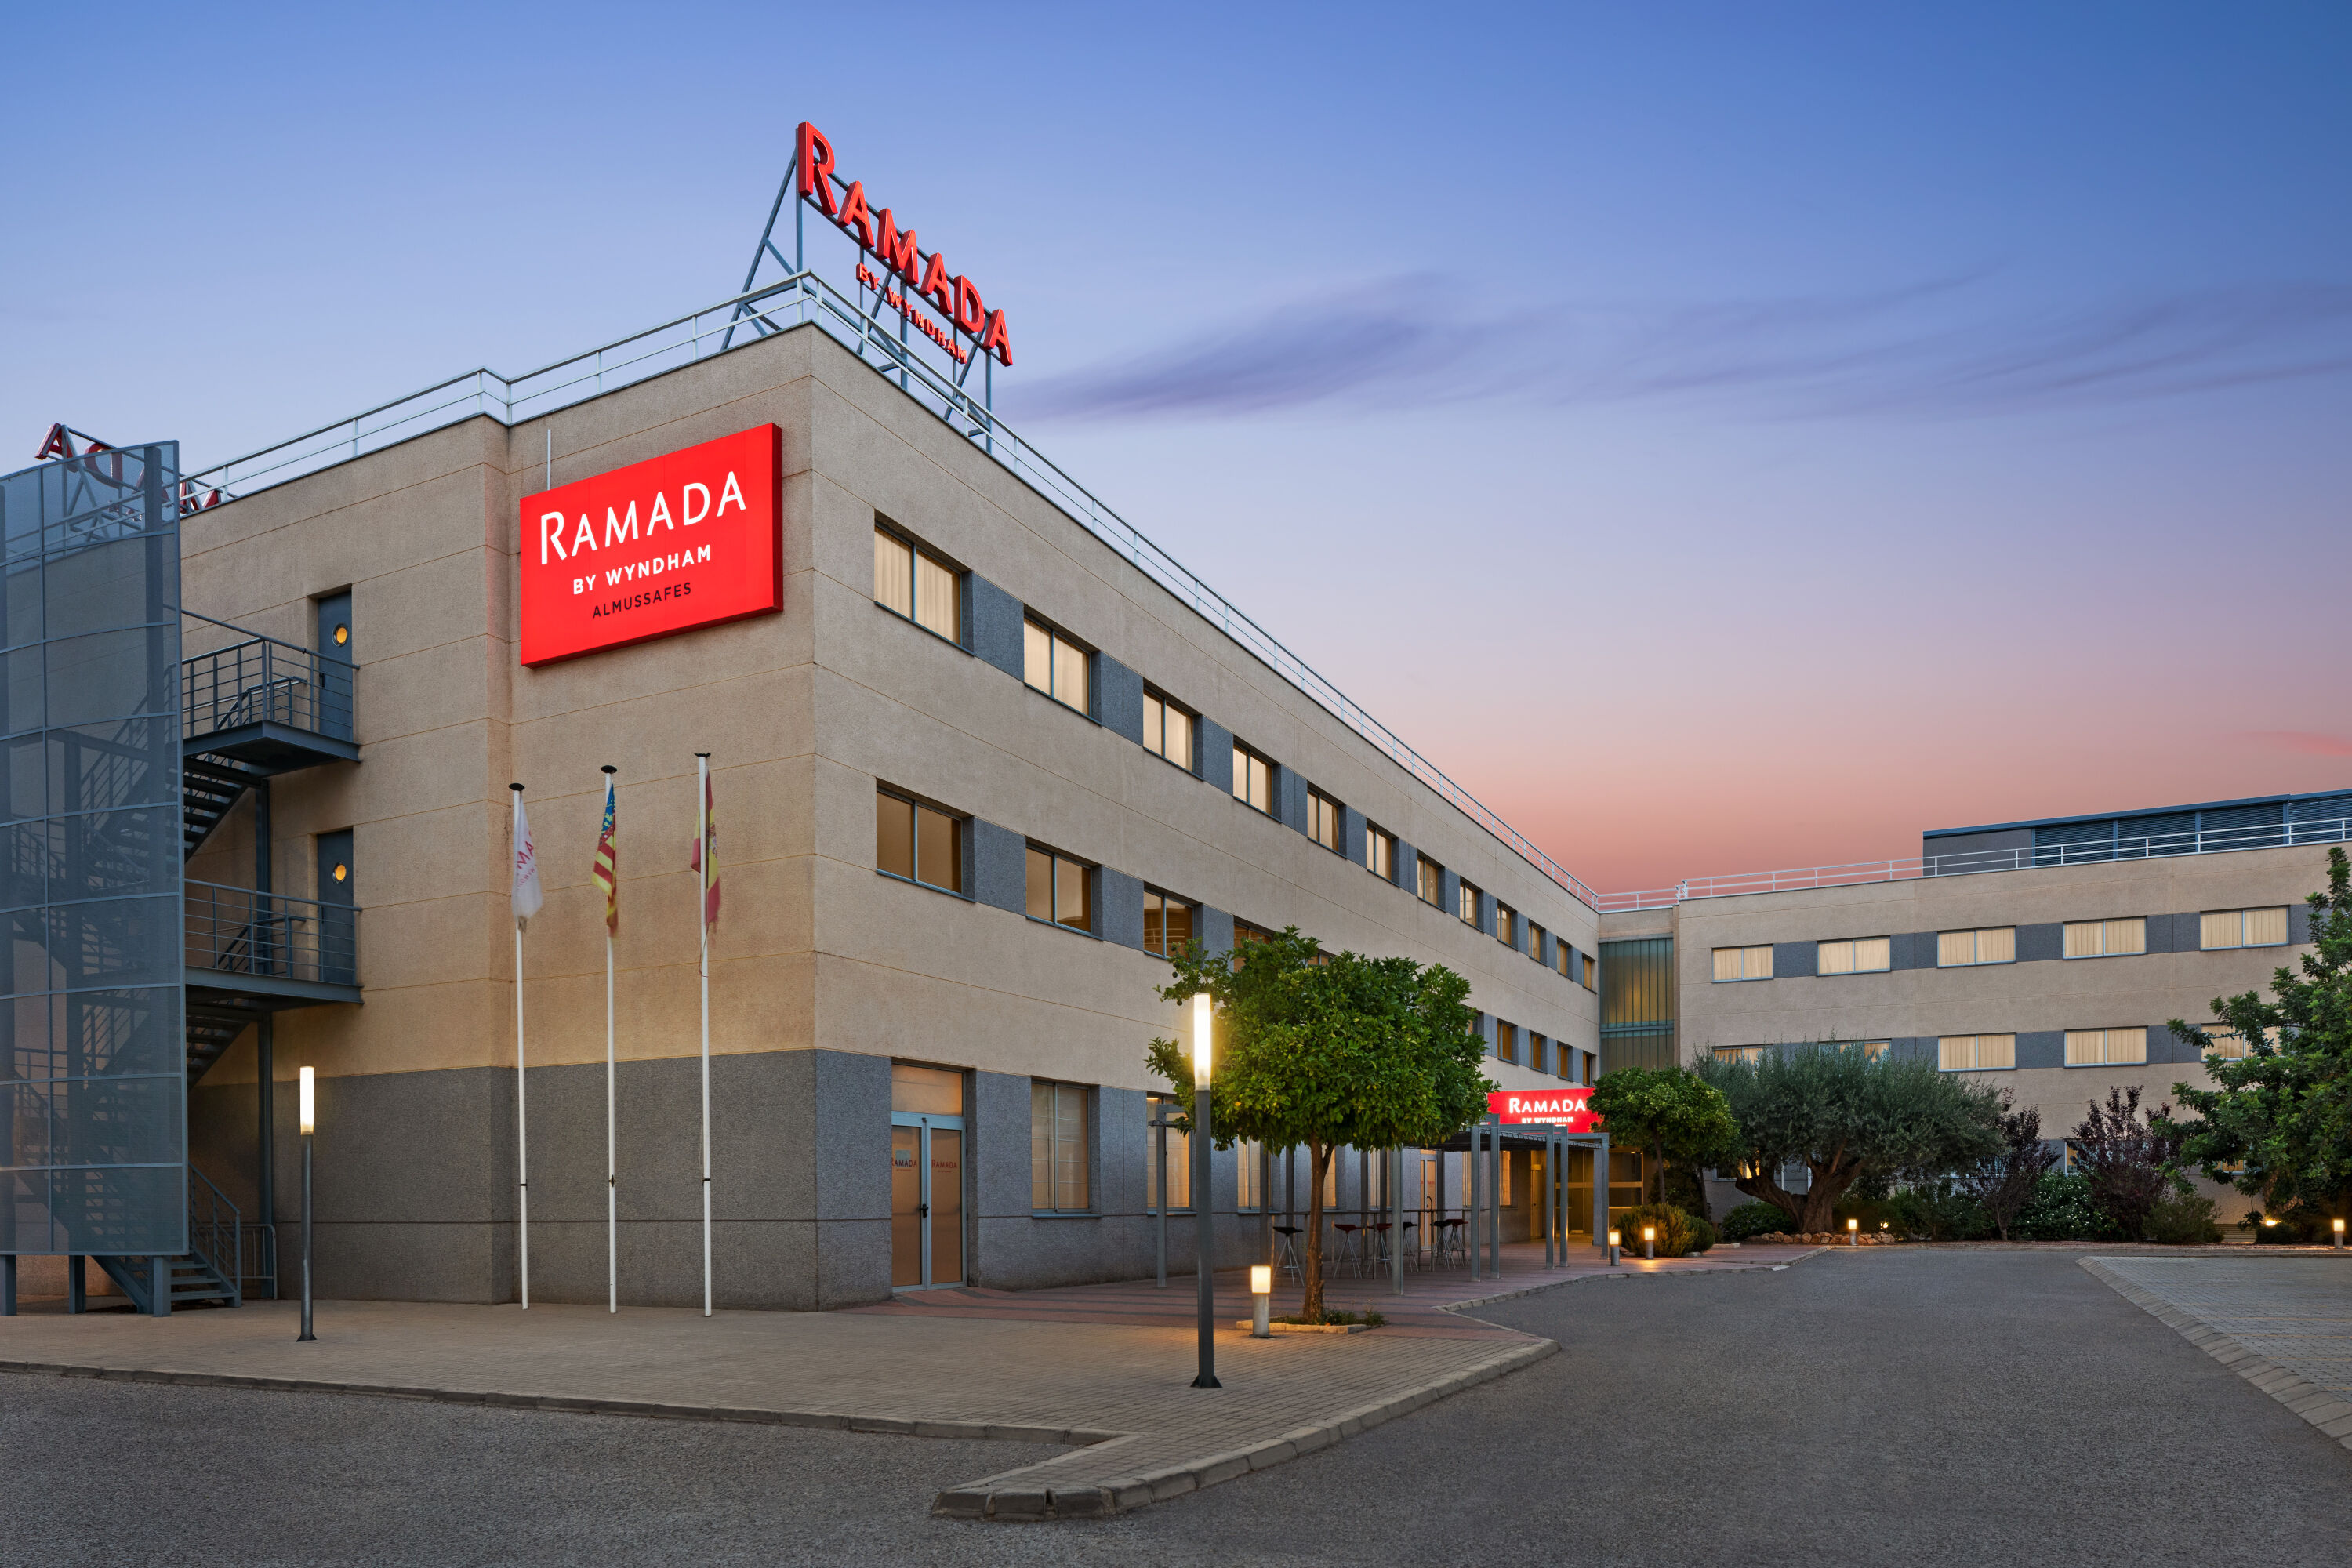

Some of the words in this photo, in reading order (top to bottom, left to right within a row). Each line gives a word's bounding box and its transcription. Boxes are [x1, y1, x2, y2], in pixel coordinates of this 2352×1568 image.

[797, 121, 1013, 367] RAMADA
[856, 262, 880, 290] BY
[885, 286, 967, 365] WYNDHAM
[541, 470, 746, 565] RAMADA
[572, 574, 597, 595] BY
[605, 544, 712, 586] WYNDHAM
[592, 582, 691, 619] ALMUSSAFES
[1509, 1098, 1586, 1114] RAMADA
[931, 1159, 958, 1169] RAMADA
